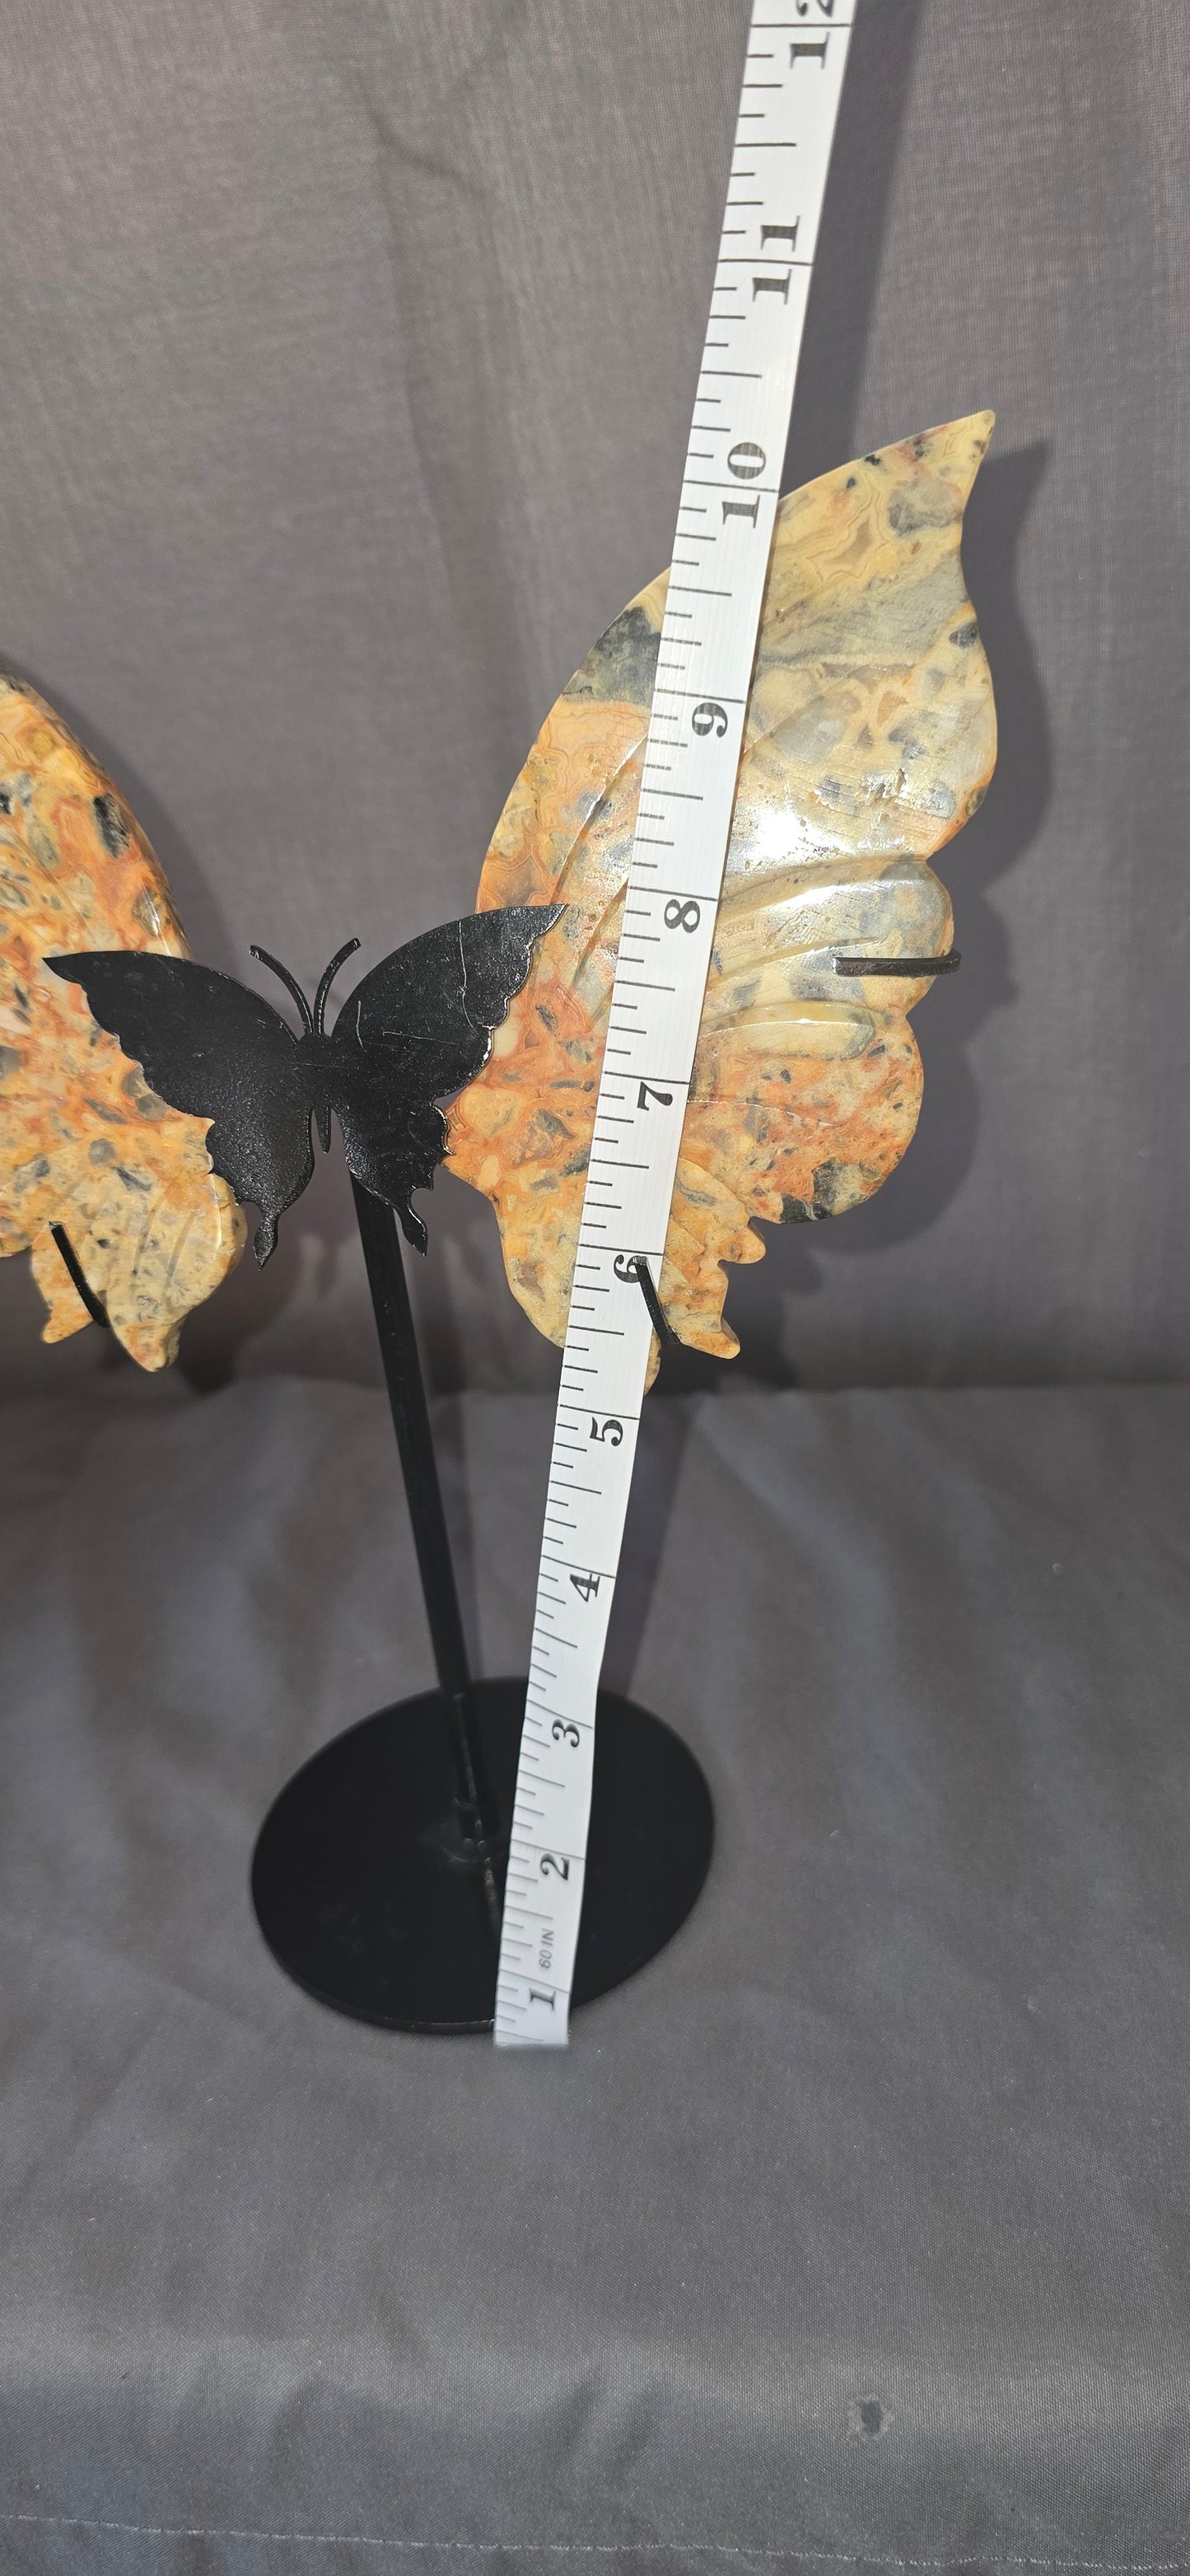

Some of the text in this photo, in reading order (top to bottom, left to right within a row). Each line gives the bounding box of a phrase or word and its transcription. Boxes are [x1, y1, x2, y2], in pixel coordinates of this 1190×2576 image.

[753, 217, 800, 305] 11
[722, 441, 766, 528] 10
[692, 702, 728, 738] 9
[664, 899, 700, 933] 8
[637, 1081, 673, 1110] 7
[614, 1254, 646, 1284] 6
[589, 1417, 624, 1447] 5
[569, 1574, 600, 1603] 4
[552, 1720, 580, 1748] 3
[539, 1853, 570, 1881] 2
[539, 1928, 554, 1970] 60 IN
[529, 1988, 556, 2011] 1
